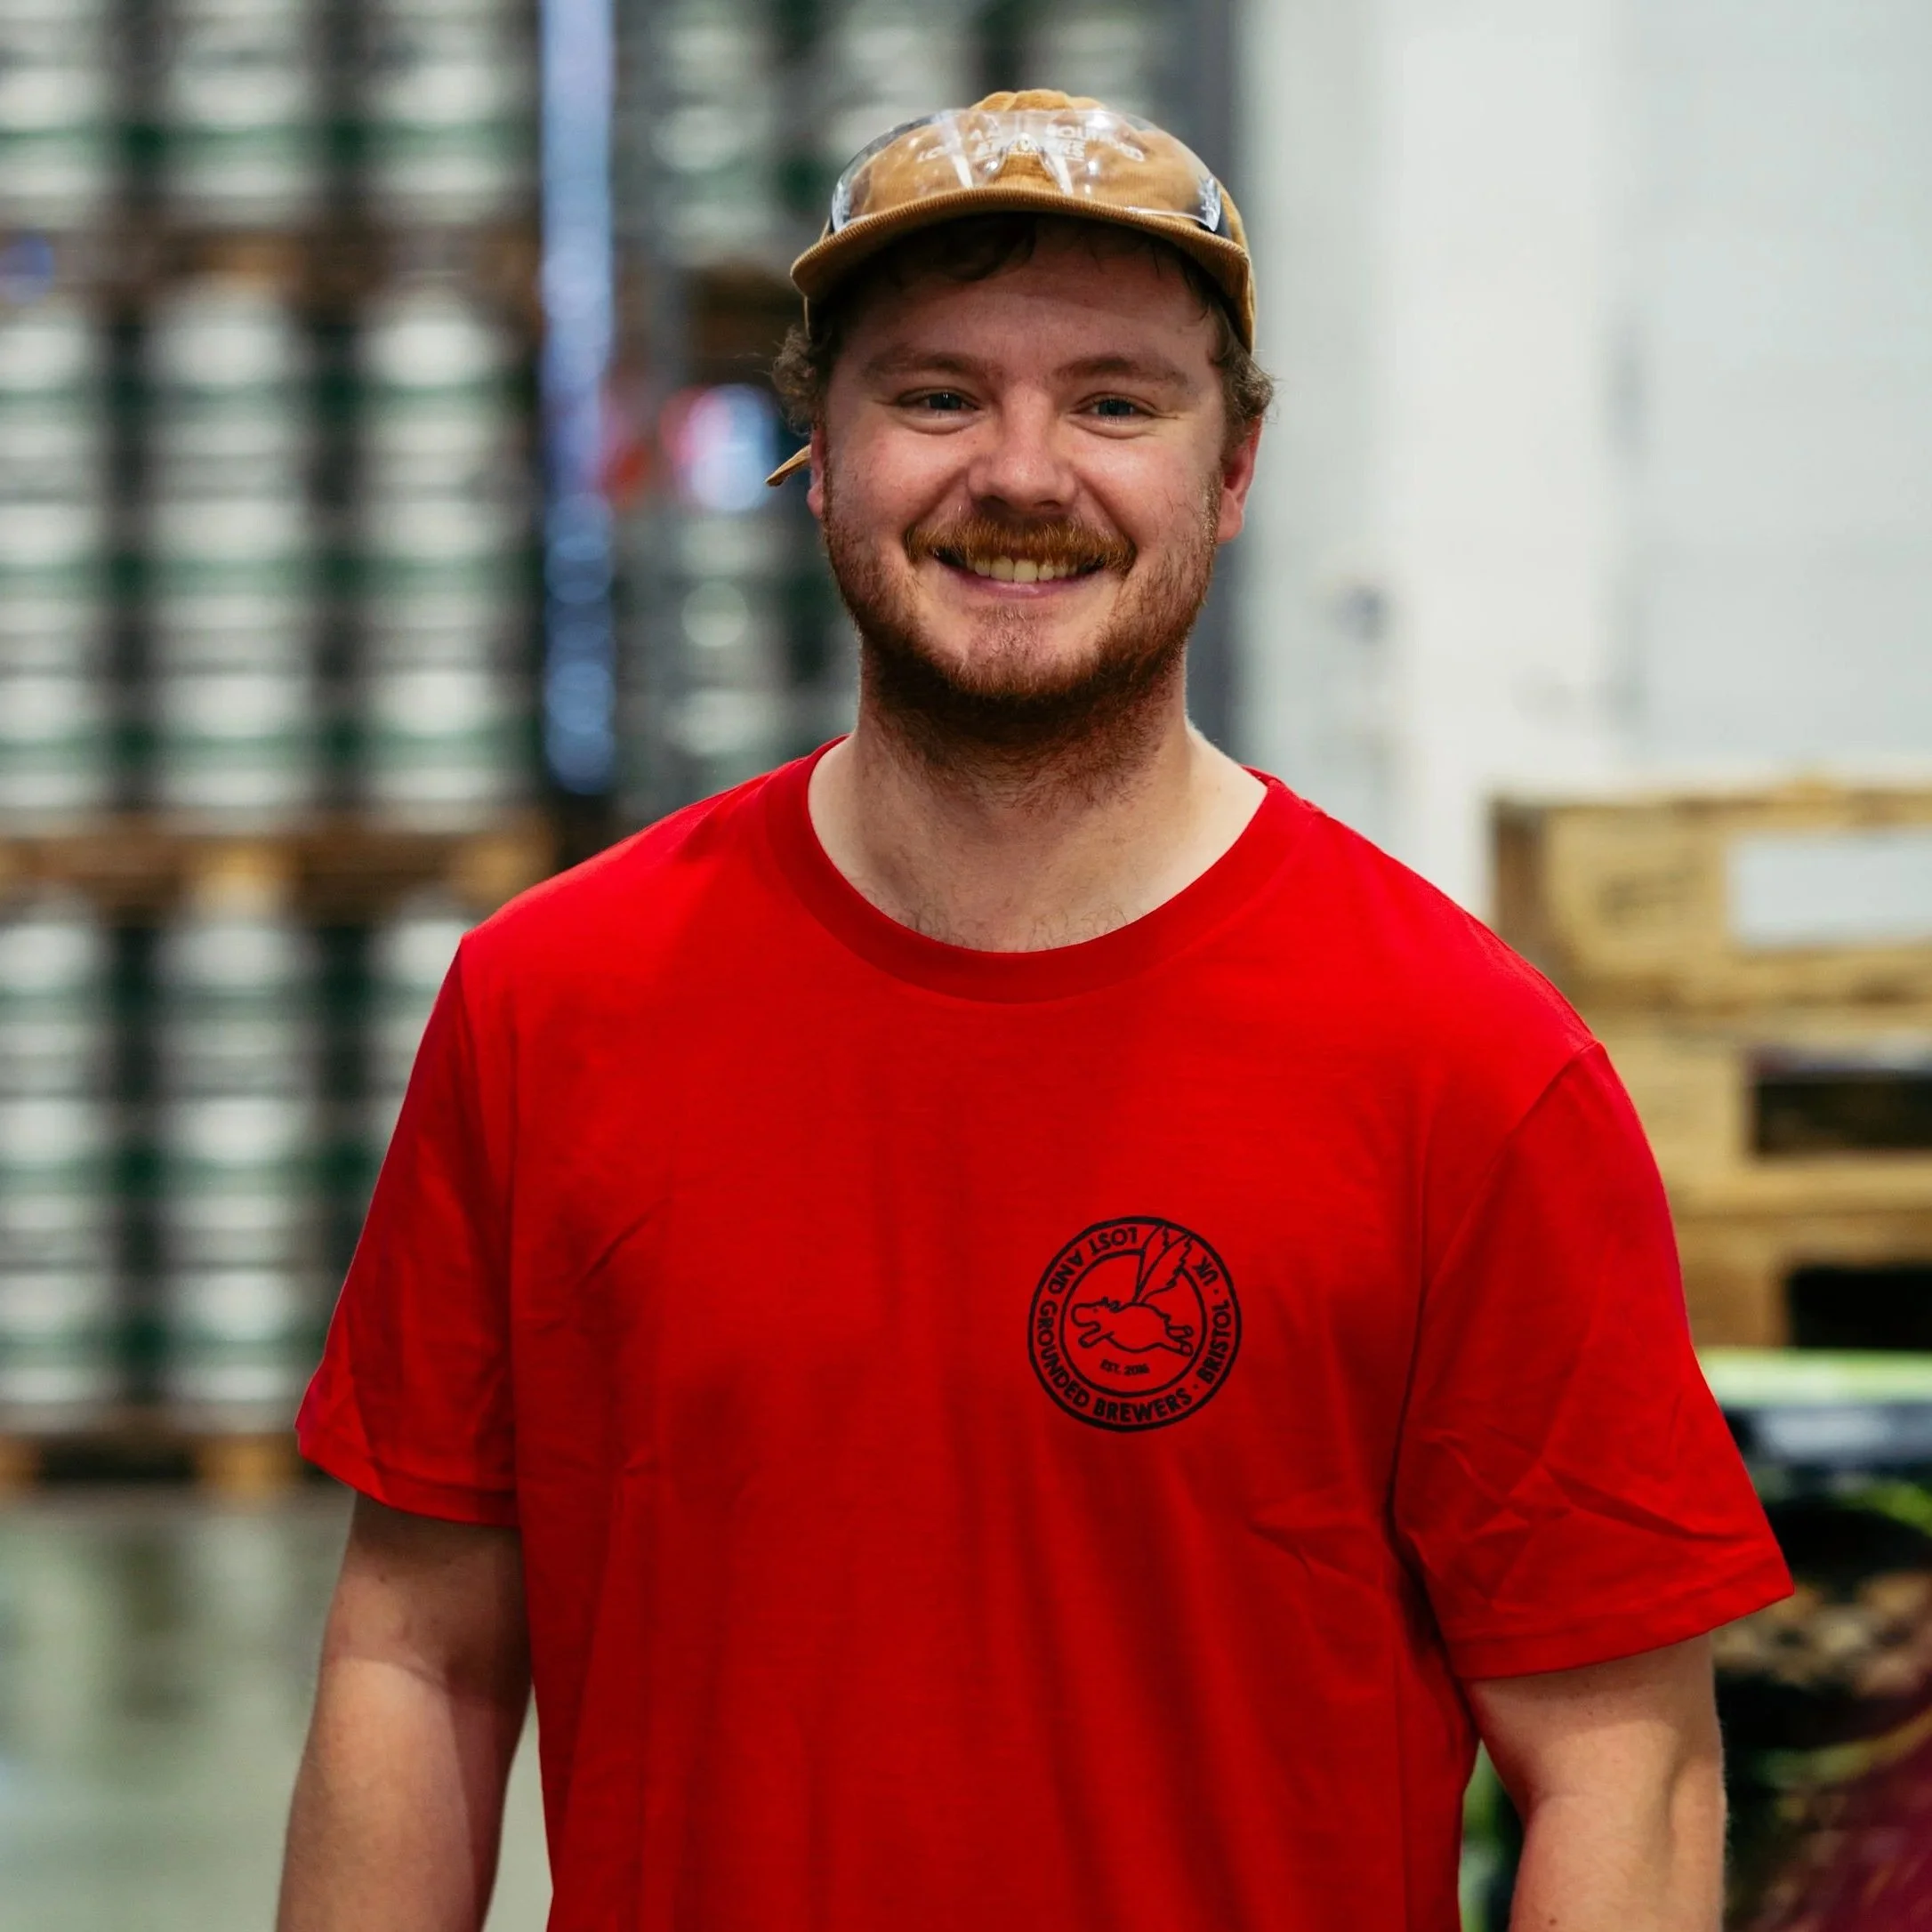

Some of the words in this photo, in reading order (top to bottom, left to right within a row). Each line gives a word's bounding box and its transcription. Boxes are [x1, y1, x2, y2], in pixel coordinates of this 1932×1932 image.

[1089, 1227, 1138, 1256] LOST
[1048, 1249, 1083, 1294] AND
[1193, 1256, 1219, 1286] UK
[1038, 1300, 1090, 1407] GROUNDED
[1196, 1300, 1231, 1384] BRISTOL
[1093, 1388, 1191, 1422] BREWERS
